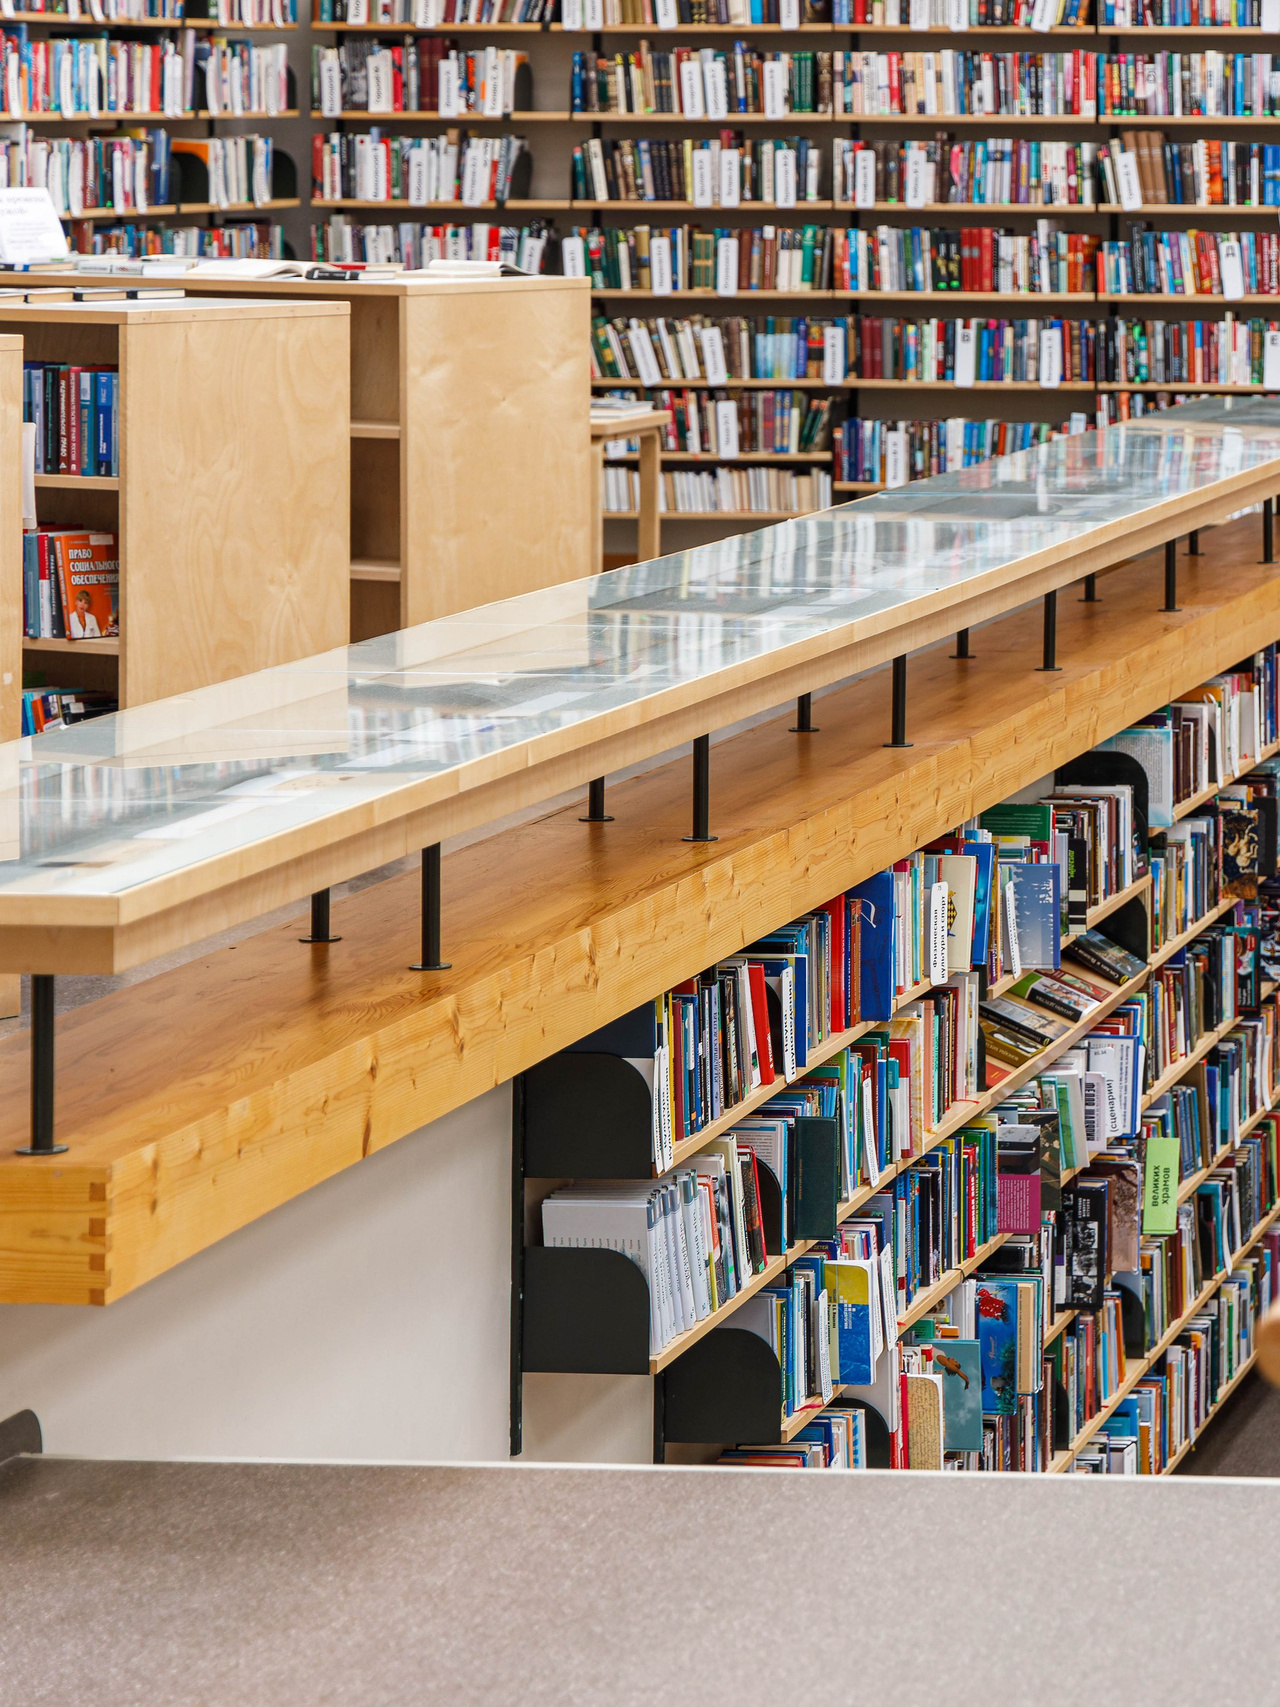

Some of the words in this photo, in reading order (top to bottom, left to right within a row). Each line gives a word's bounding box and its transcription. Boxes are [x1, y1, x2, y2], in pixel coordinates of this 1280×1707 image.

[68, 548, 92, 560] ПРАВО
[1106, 1079, 1119, 1132] (сценарии)
[1151, 1165, 1161, 1207] великих
[1161, 1167, 1171, 1205] храмов
